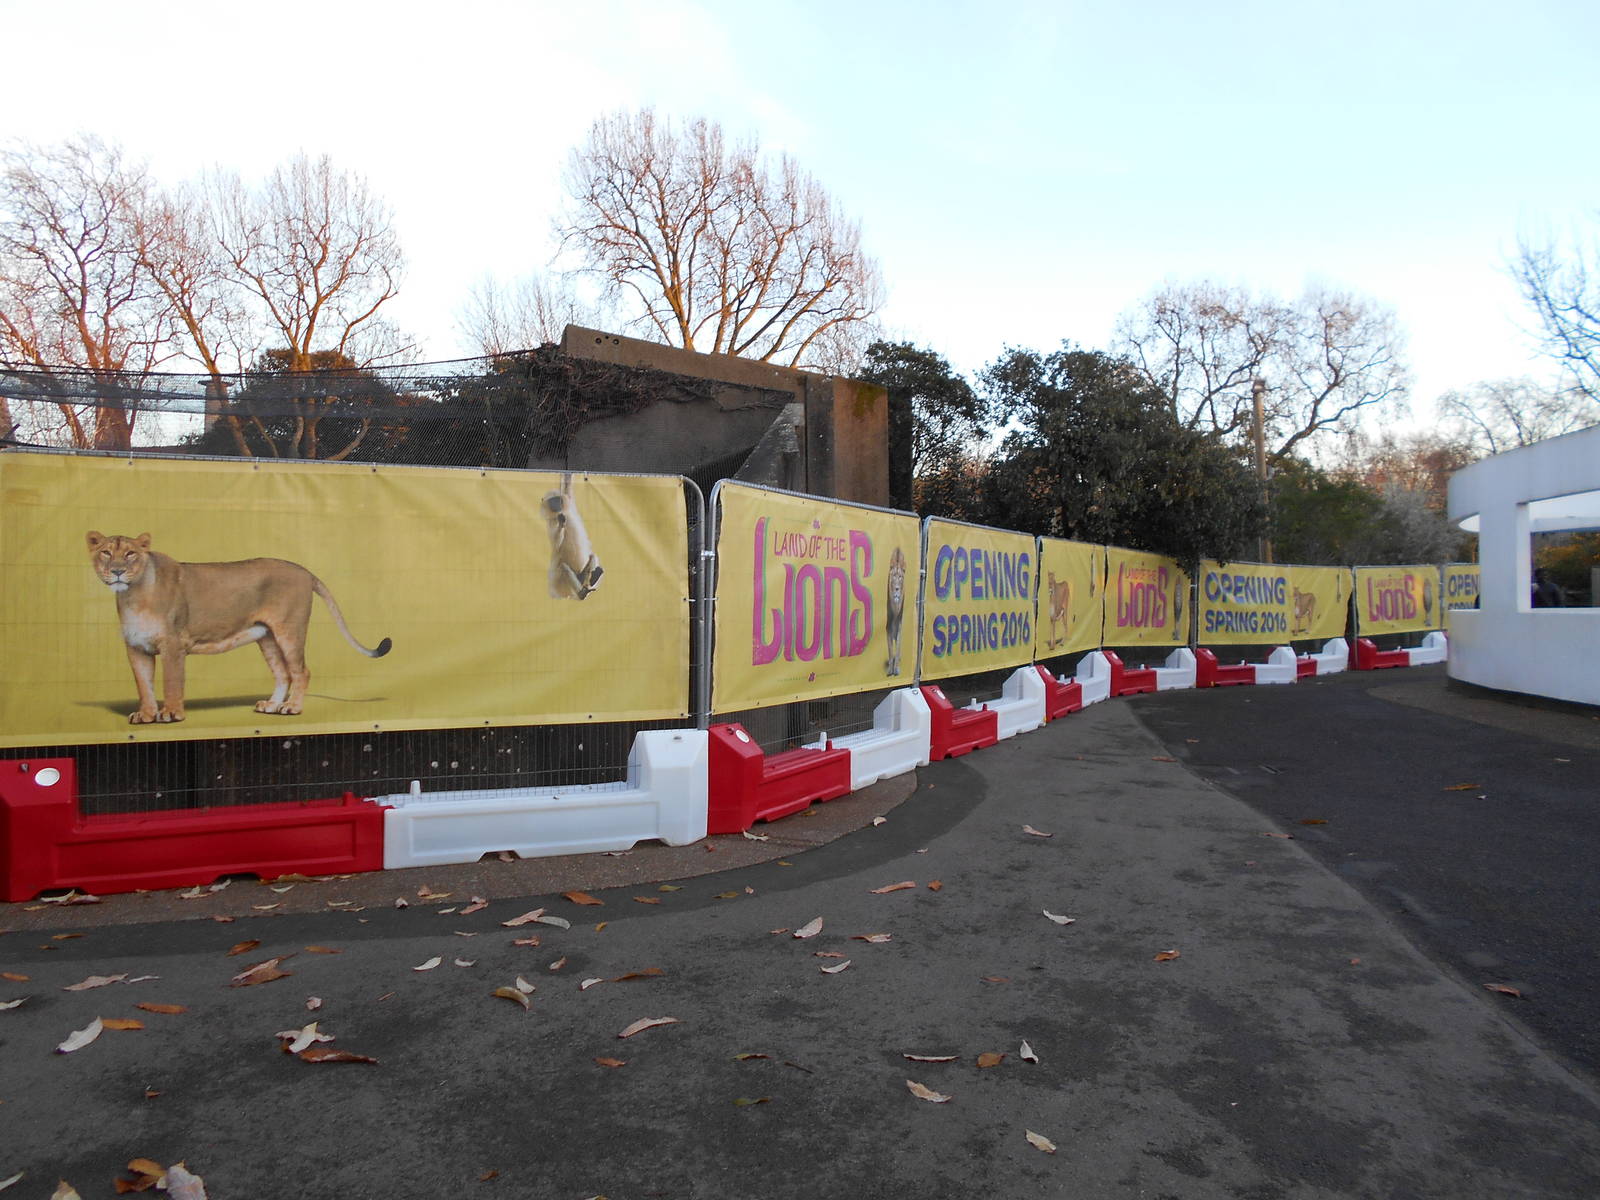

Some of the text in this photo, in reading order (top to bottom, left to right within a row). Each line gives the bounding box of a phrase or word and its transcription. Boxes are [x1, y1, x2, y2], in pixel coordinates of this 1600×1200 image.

[774, 531, 846, 561] LAND OF THE
[934, 544, 1030, 602] OPENING
[1205, 572, 1286, 605] OPENING
[932, 611, 1030, 658] SPRING 2016
[1205, 610, 1286, 633] SPRING 2016
